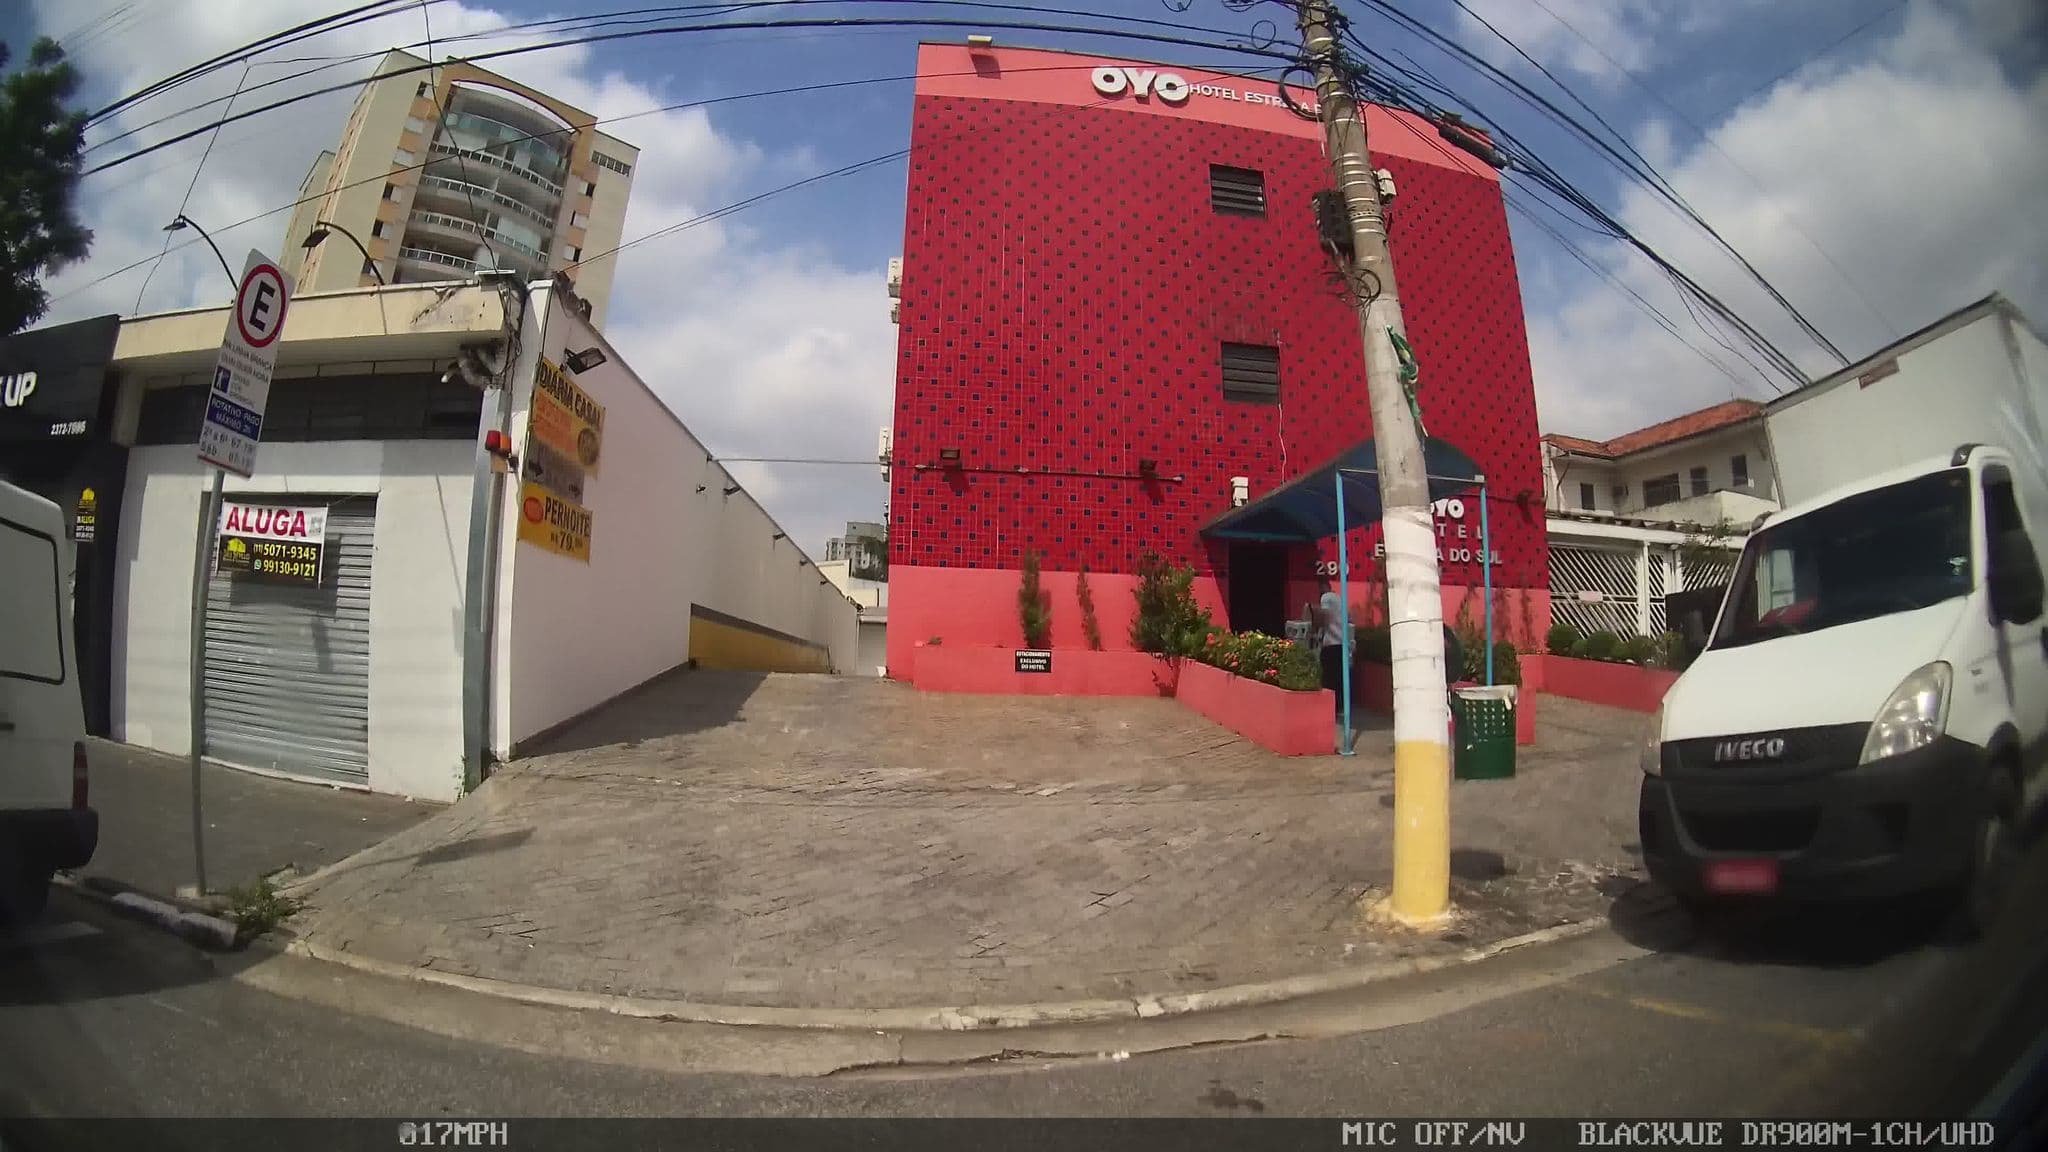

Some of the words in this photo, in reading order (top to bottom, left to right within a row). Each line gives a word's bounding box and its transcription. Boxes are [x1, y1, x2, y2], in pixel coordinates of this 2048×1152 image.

[1091, 67, 1190, 103] OYO
[1190, 83, 1241, 101] HOTEL
[249, 280, 277, 333] E
[4, 371, 37, 407] UP
[226, 506, 307, 538] ALUGA
[544, 495, 590, 537] PERNOITE
[1430, 498, 1464, 519] YO
[263, 559, 316, 577] 99130-9121
[1449, 548, 1471, 562] DO
[1714, 738, 1785, 762] IVECO
